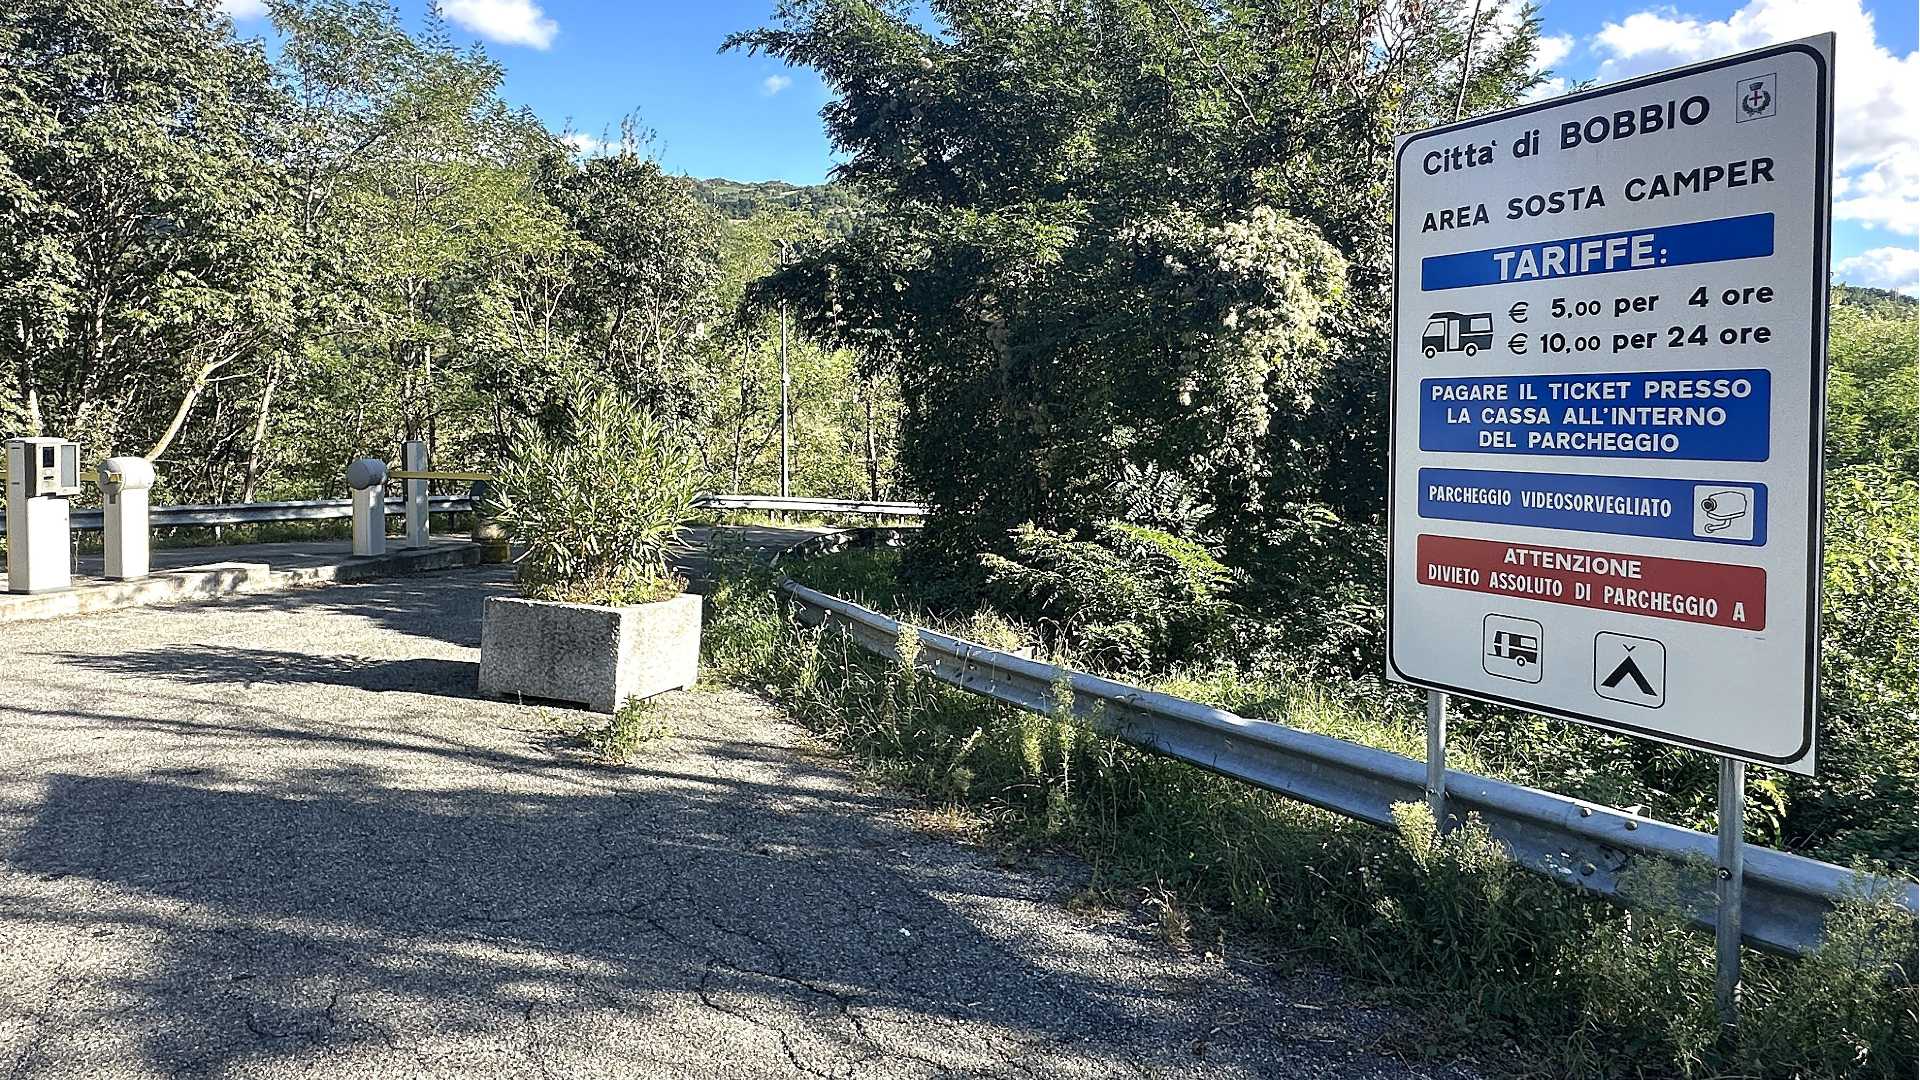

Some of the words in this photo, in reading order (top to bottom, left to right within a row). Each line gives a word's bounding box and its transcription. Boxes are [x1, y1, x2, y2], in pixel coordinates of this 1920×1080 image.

[1513, 130, 1539, 158] di
[1561, 96, 1710, 150] BOBBIO
[1422, 204, 1489, 233] AREA
[1506, 186, 1605, 219] SOSTA
[1625, 157, 1775, 201] CAMPER
[1494, 234, 1667, 281] TARIFFE:
[1509, 302, 1529, 323] €
[1614, 295, 1659, 316] per
[1689, 287, 1708, 307] 4
[1721, 285, 1774, 306] ore
[1508, 333, 1528, 354] €
[1613, 332, 1657, 353] per
[1667, 325, 1708, 347] 24
[1720, 325, 1772, 345] ore
[1432, 385, 1508, 401] PAGARE
[1520, 384, 1537, 400] IL
[1549, 382, 1631, 399] TICKET
[1644, 379, 1752, 399] PRESSO
[1447, 407, 1470, 424] LA
[1481, 407, 1550, 425] CASSA
[1563, 407, 1726, 426] ALL'INTERNO
[1479, 431, 1516, 448] DEL
[1529, 433, 1679, 452] PARCHEGGIO
[1429, 486, 1511, 506] PARCHEGGIO
[1521, 491, 1672, 518] VIDEOSORVEGLIATO
[1504, 548, 1642, 579] ATTENZIONE
[1428, 564, 1480, 586] DIVIETO
[1489, 573, 1563, 597] ASSOLUTO
[1576, 583, 1591, 601] DI
[1604, 587, 1717, 618] PARCHEGGIO
[1733, 602, 1745, 622] A
